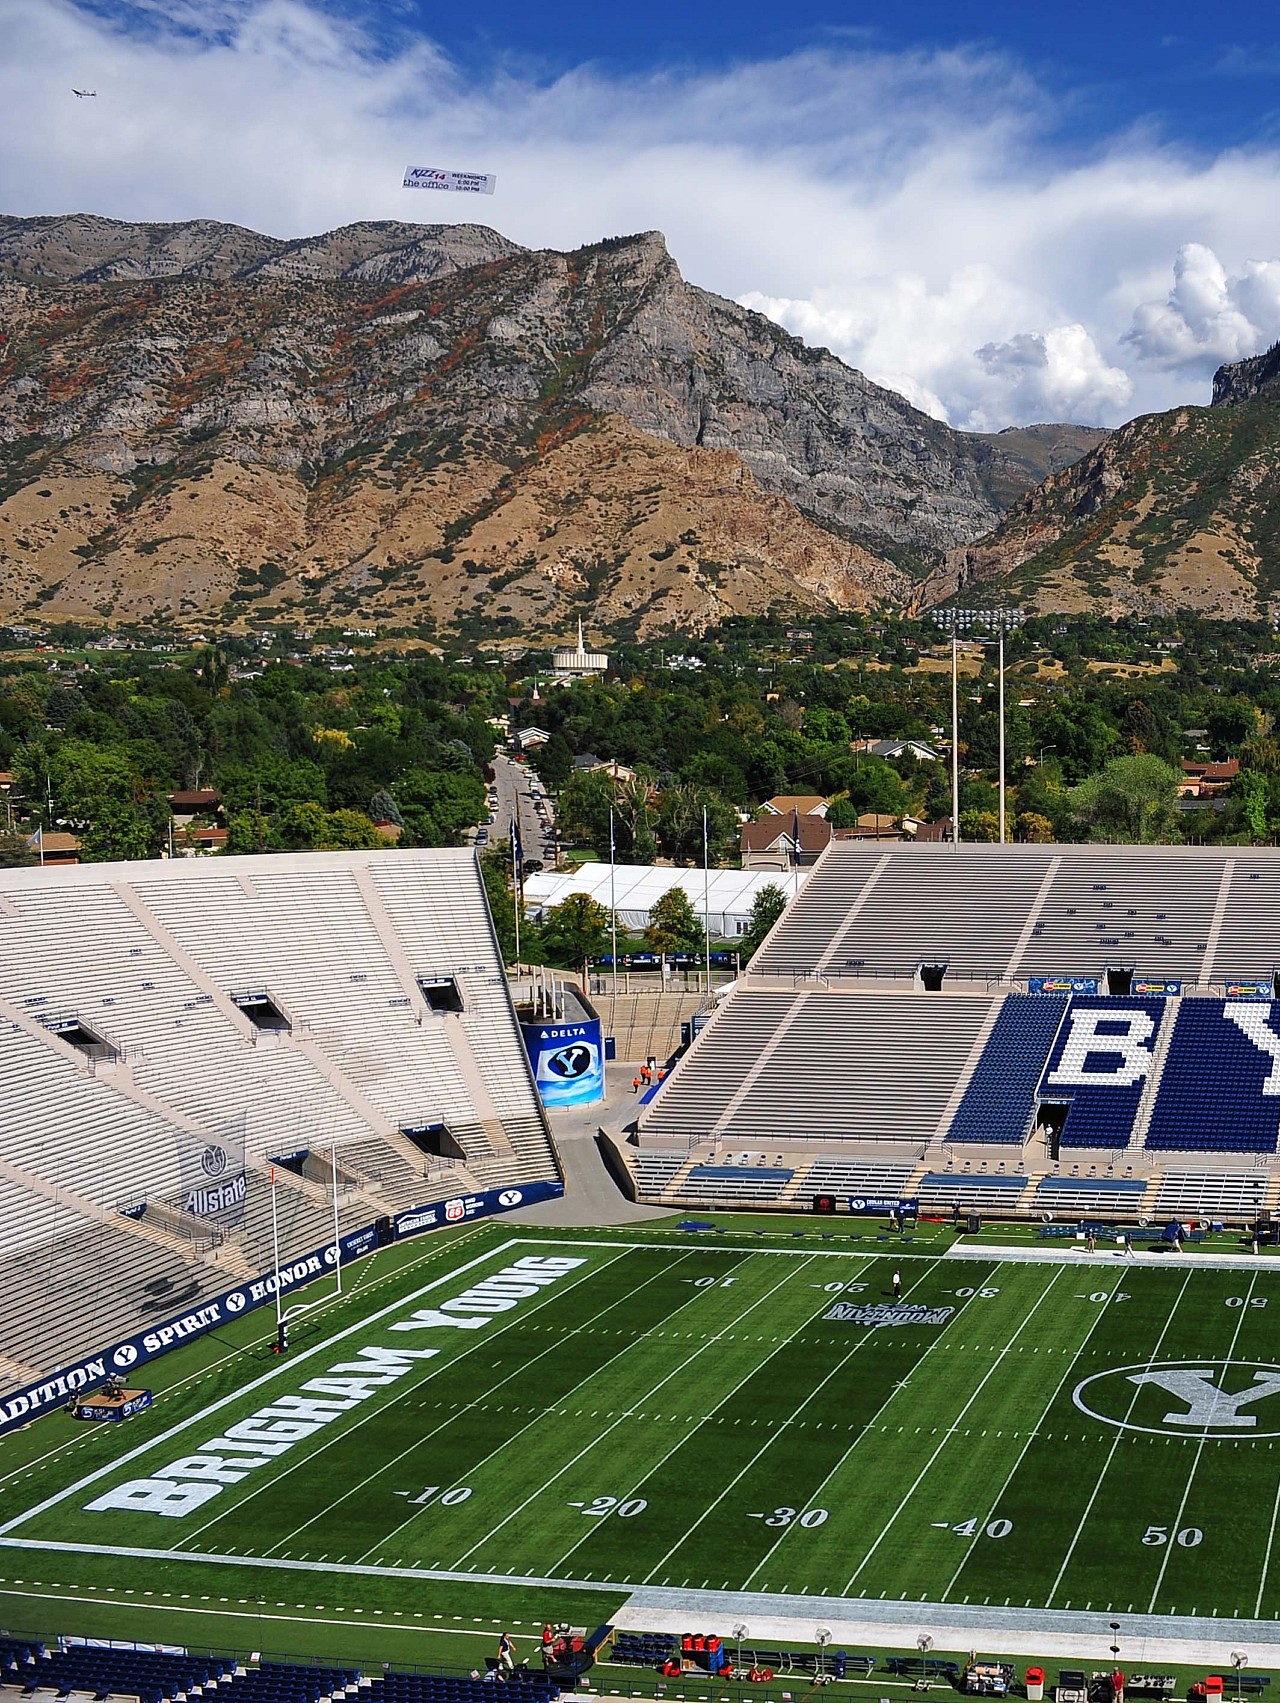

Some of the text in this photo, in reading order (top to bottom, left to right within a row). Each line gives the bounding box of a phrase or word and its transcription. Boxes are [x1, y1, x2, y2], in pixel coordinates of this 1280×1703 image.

[403, 179, 449, 190] the office
[410, 168, 436, 178] KJZZ
[551, 1028, 586, 1038] DELTA
[556, 1048, 584, 1075] Y
[182, 1175, 247, 1214] Allstate
[448, 1206, 462, 1218] 66
[143, 1303, 222, 1353] SPIRIT
[249, 1256, 323, 1302] HONOR
[82, 1255, 589, 1518] BRIGHAM YOUNG
[406, 1486, 473, 1506] 10
[581, 1496, 649, 1518] 20
[765, 1506, 830, 1529] 30
[951, 1516, 1014, 1539] 40
[1141, 1525, 1204, 1548] 50
